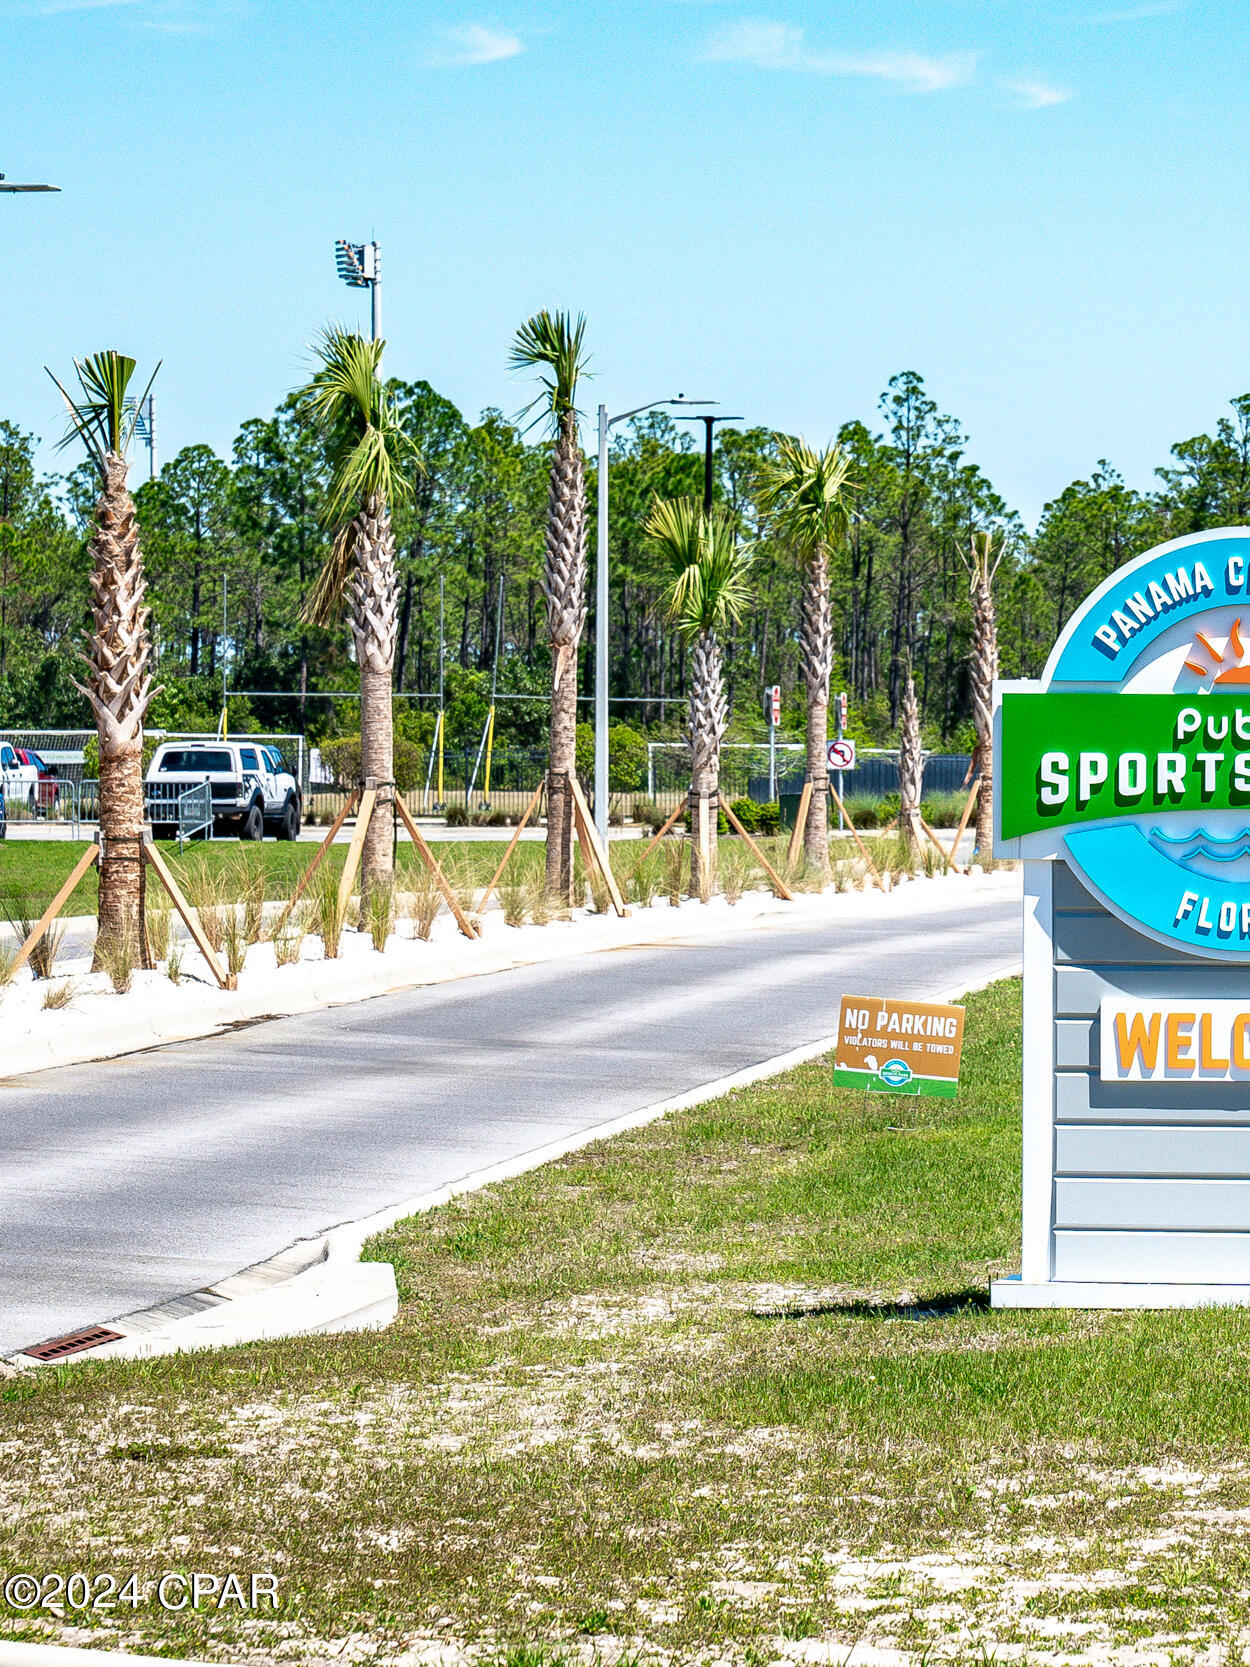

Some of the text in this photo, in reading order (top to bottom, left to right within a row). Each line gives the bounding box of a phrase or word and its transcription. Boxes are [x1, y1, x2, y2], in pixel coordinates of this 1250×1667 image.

[1092, 561, 1214, 660] PANAMA
[844, 1008, 958, 1039] NO PARKING
[843, 1035, 955, 1055] VIOLATORS WILL BE TOWED
